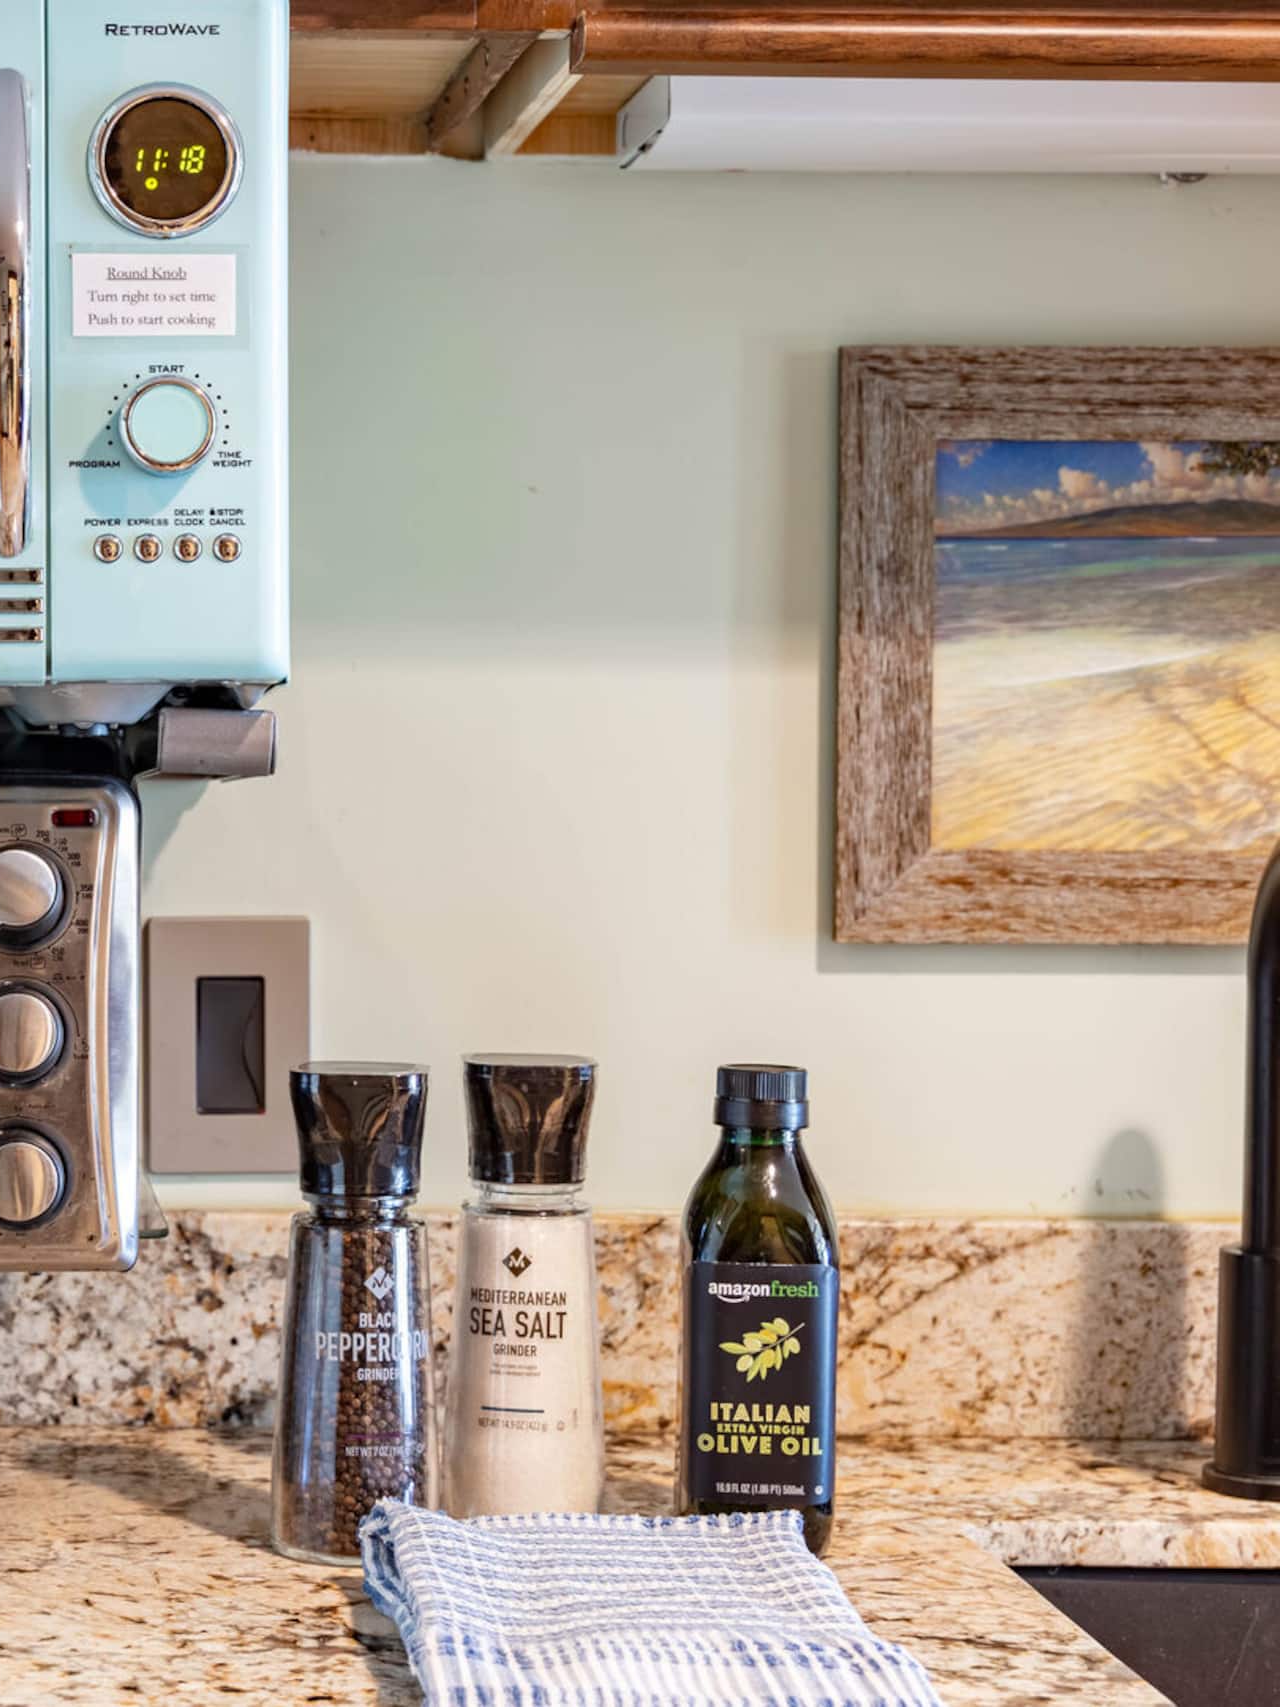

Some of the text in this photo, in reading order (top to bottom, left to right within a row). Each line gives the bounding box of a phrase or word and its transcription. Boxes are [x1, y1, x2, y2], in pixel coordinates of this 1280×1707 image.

[135, 145, 206, 174] 11:18
[106, 266, 187, 280] Round Knob
[88, 290, 217, 305] Turn right to set time
[88, 313, 216, 328] Push to start cooking
[148, 364, 185, 374] START
[216, 451, 242, 459] TIME
[69, 460, 121, 468] PROGRAM
[212, 459, 253, 468] WEIGHT
[84, 518, 121, 527] POWER
[127, 518, 169, 527] EXPRESS
[174, 518, 205, 527] CLOCK
[209, 518, 246, 527] CANCEL
[471, 1288, 567, 1306] MEDITERRANEAN
[470, 1307, 567, 1339] SEA SALT
[493, 1343, 537, 1357] GRINDER
[710, 1402, 811, 1425] ITALIAN
[716, 1423, 805, 1436] EXTRA VIRGIN
[696, 1433, 823, 1456] OLIVE OIL
[731, 1482, 740, 1494] FL
[740, 1482, 751, 1494] OZ
